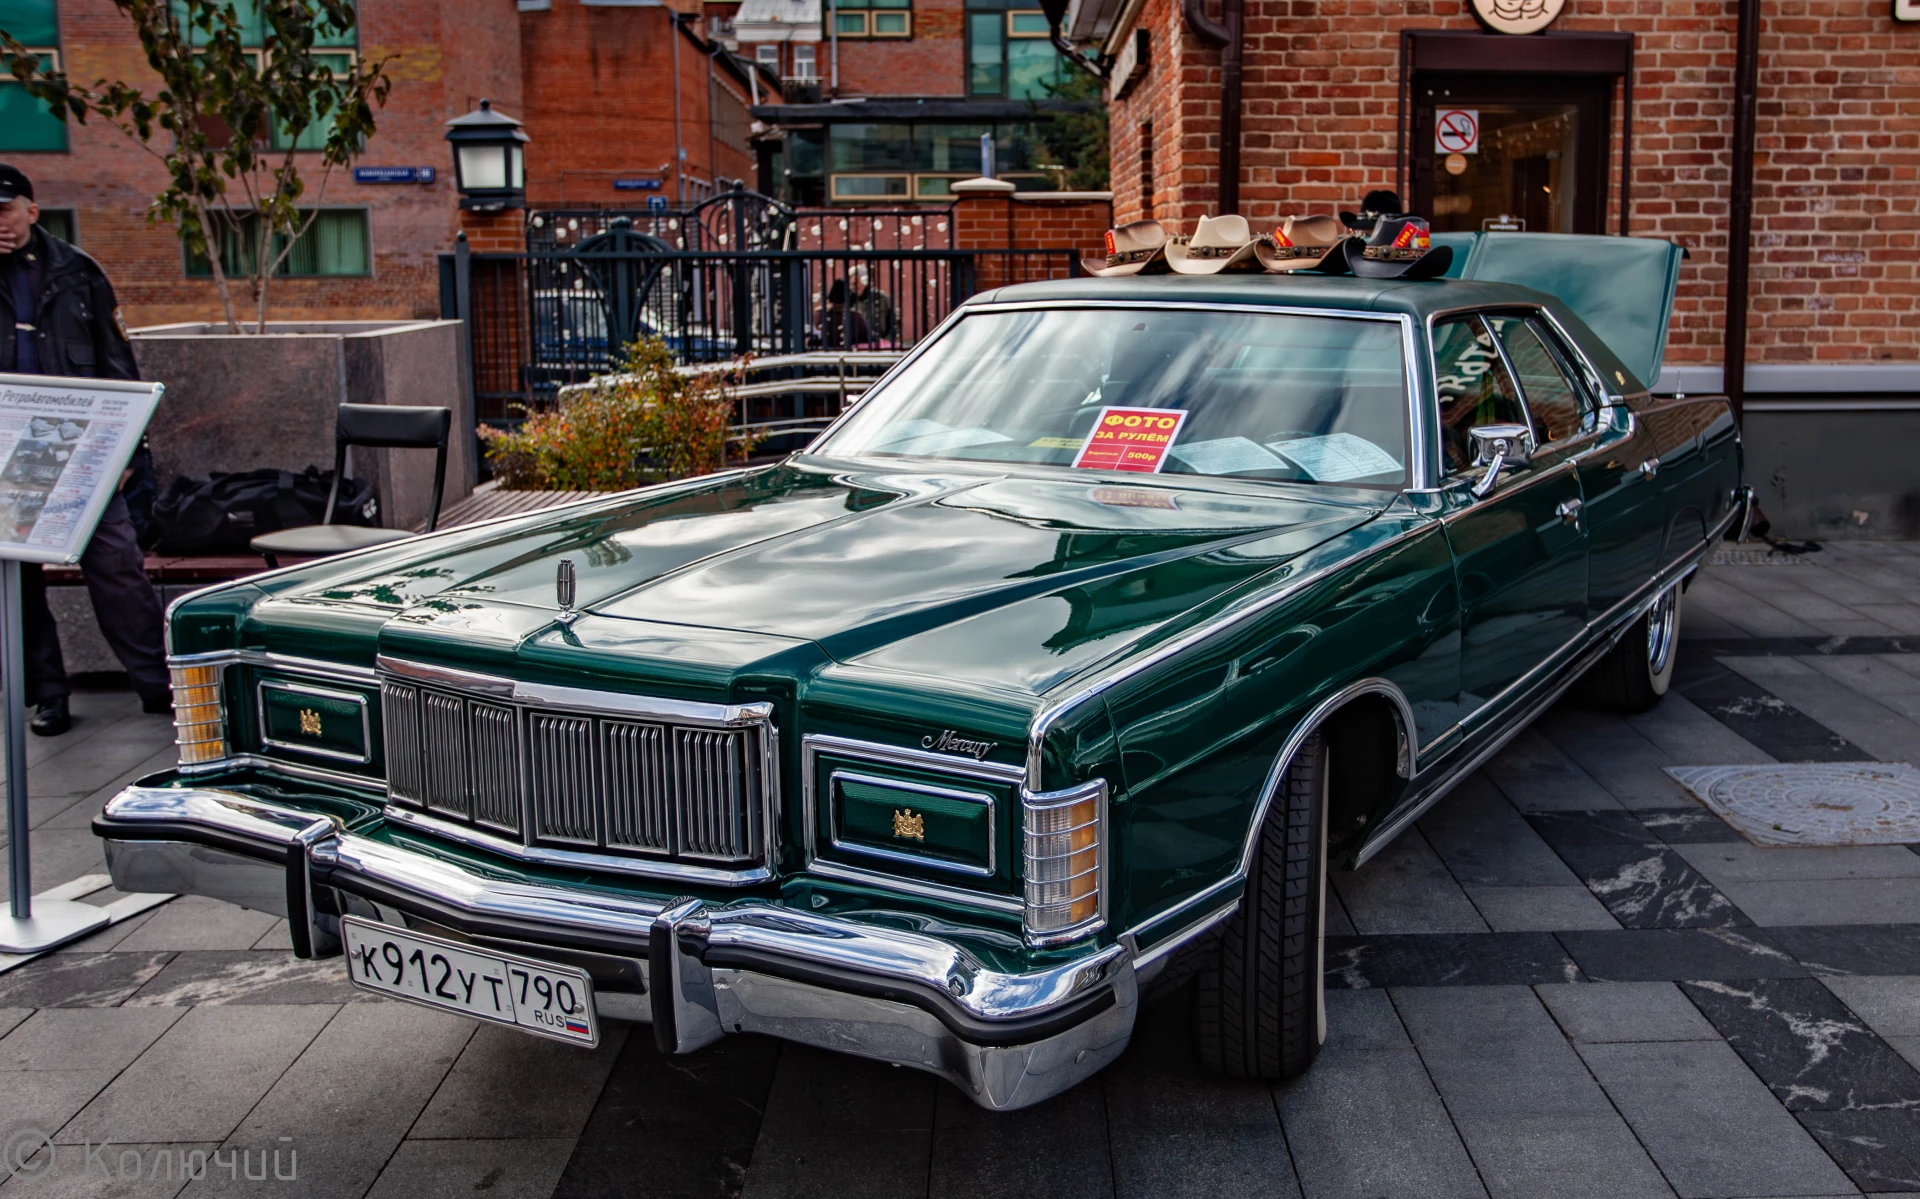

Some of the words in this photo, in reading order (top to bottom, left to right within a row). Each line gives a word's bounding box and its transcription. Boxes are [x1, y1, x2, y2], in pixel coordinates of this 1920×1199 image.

[1104, 415, 1176, 429] ФОТО
[1095, 431, 1114, 439] ЗА
[1117, 431, 1170, 443] РУЛЁМ
[1126, 451, 1157, 461] 500р
[921, 729, 999, 759] Mercury
[360, 941, 504, 1012] К912УТ
[511, 968, 577, 1015] 790
[534, 1009, 565, 1028] RUS
